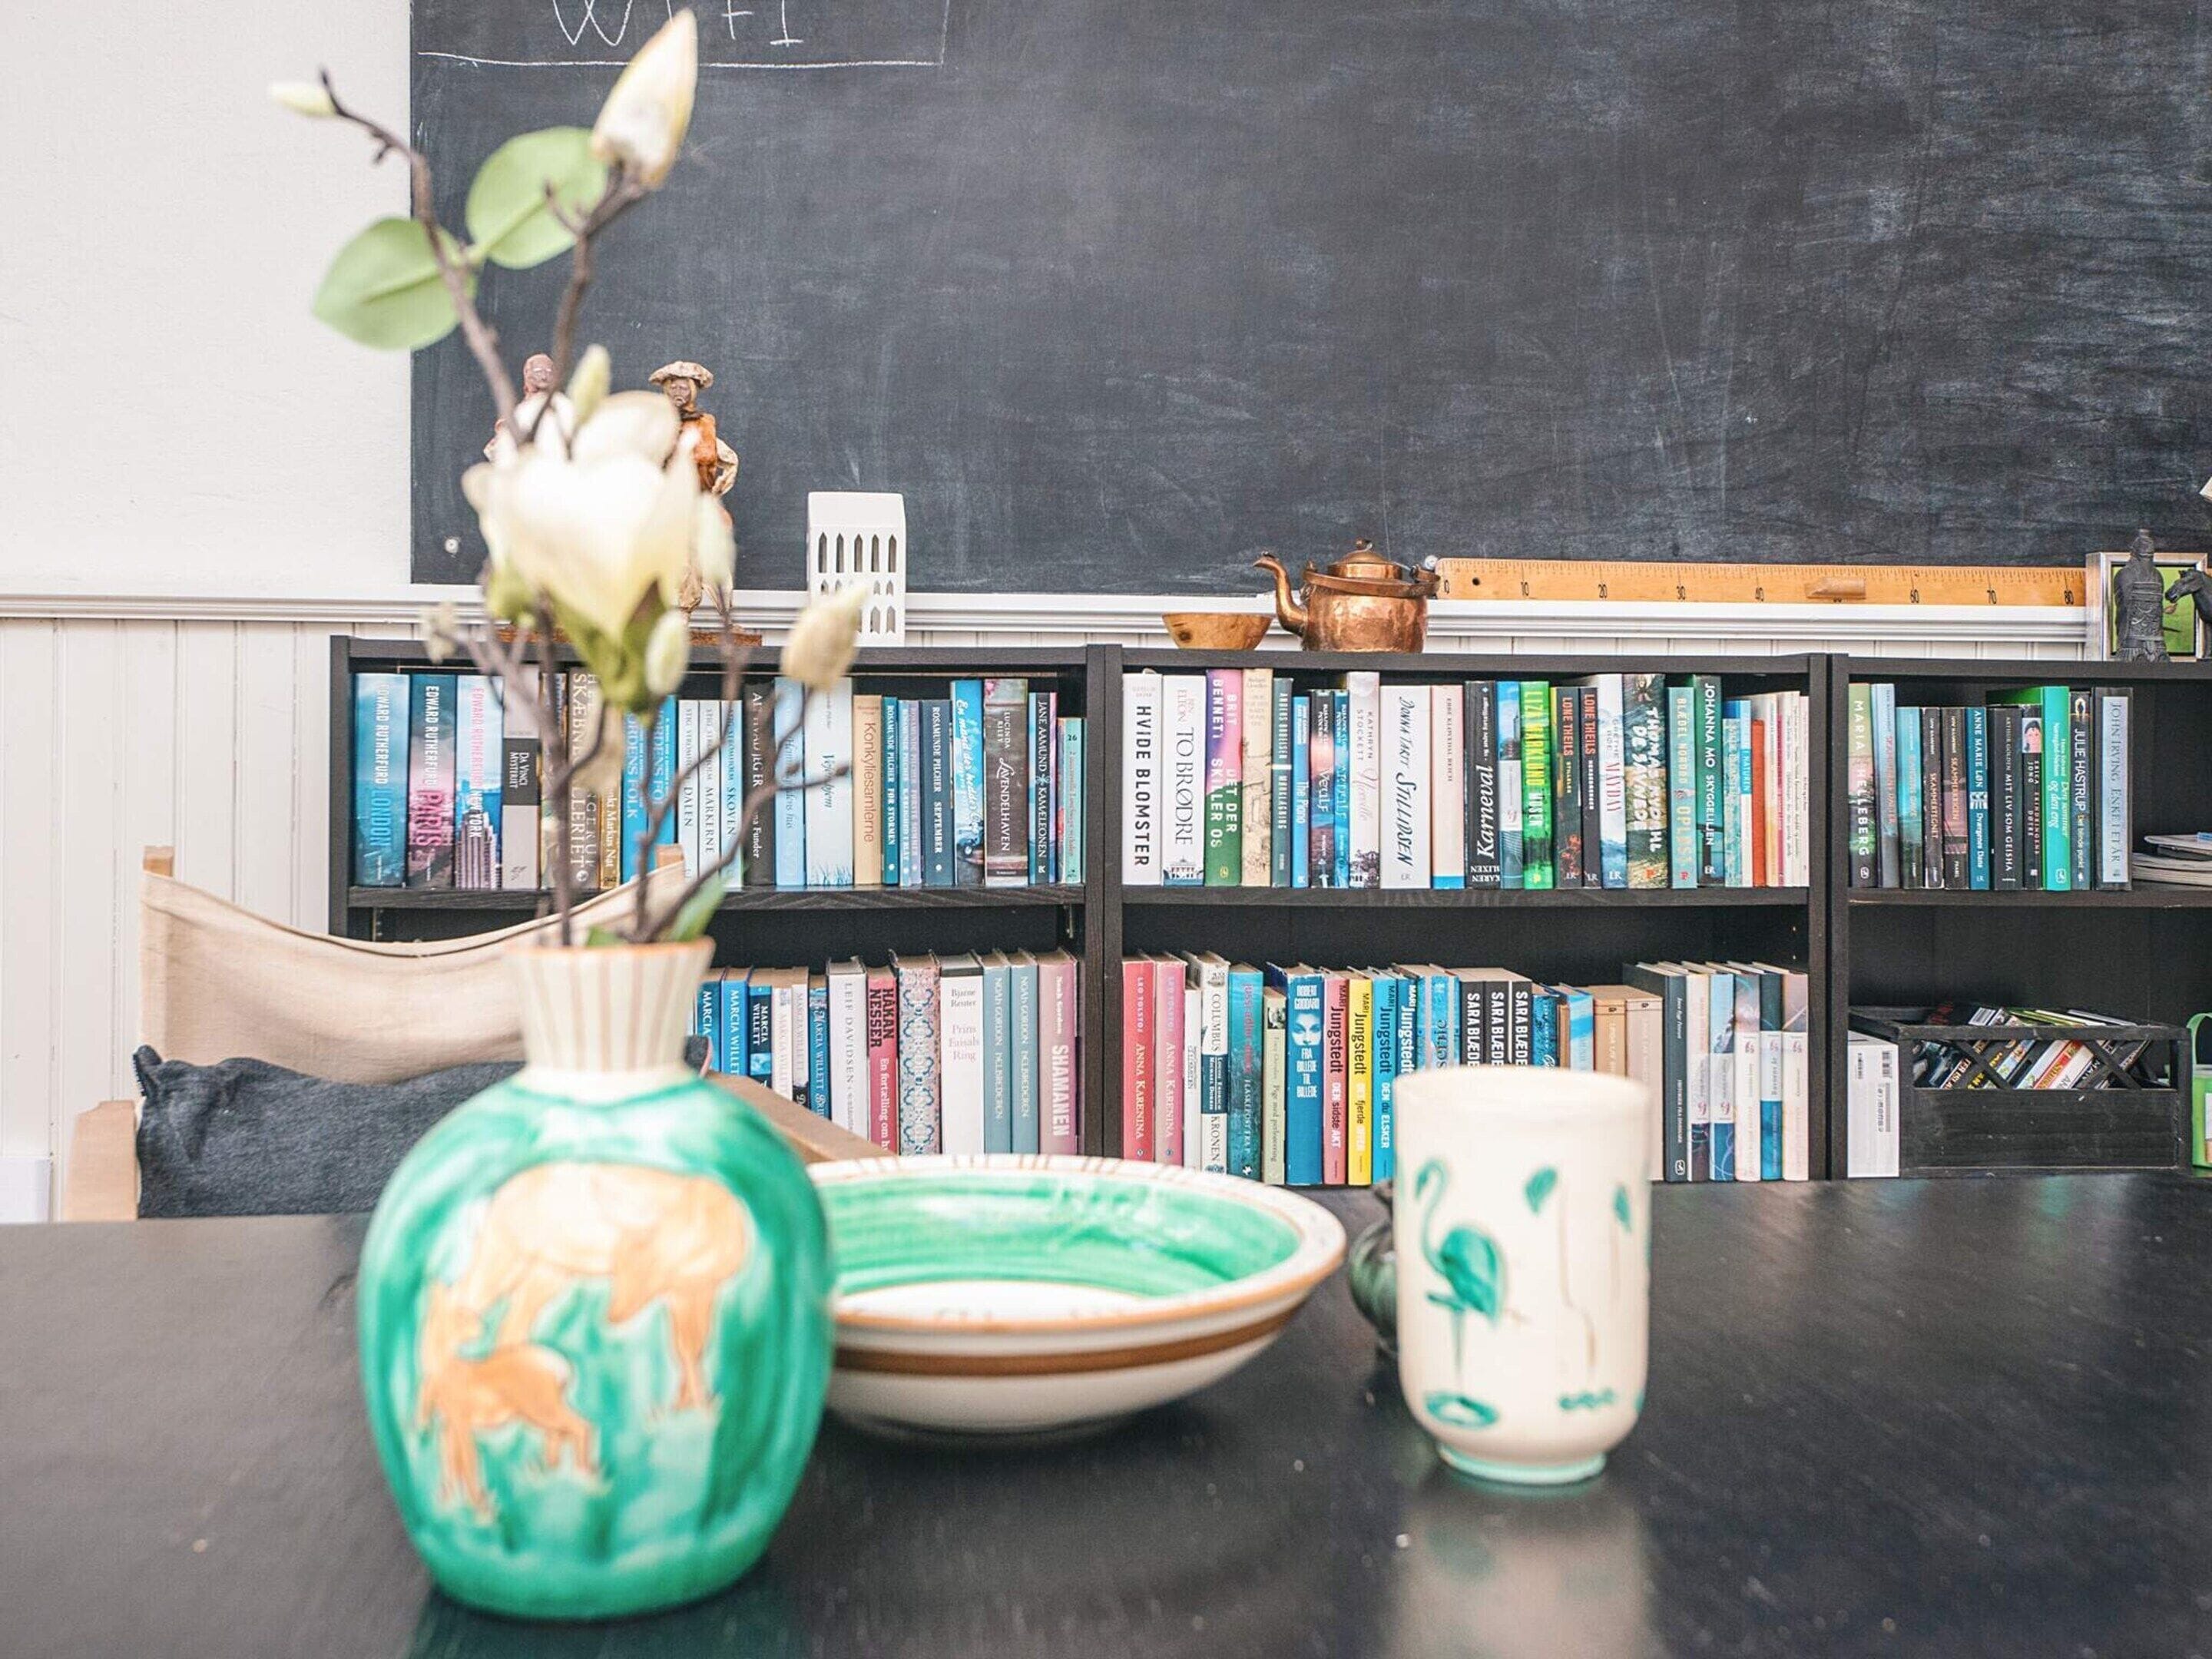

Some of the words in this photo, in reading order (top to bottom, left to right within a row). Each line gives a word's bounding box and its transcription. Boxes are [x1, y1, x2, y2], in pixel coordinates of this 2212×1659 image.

[1520, 581, 1529, 596] 10
[1598, 583, 1608, 598] 20
[1676, 584, 1686, 600] 30
[1755, 587, 1764, 602] 40
[1909, 589, 1919, 604] 60
[1987, 590, 1997, 604] 70
[2065, 591, 2074, 605] 80
[376, 684, 390, 721] EDWARD
[424, 685, 439, 723] EDWARD
[469, 688, 485, 725] EDWARD
[1038, 700, 1048, 725] JANE
[1212, 678, 1224, 740] BENNETT
[1227, 694, 1237, 726] BRIT
[1399, 697, 1416, 735] DONNA
[1524, 692, 1543, 722] LIZA
[1562, 697, 1573, 722] LONE
[1584, 694, 1595, 719] LONE
[1677, 697, 1688, 739] BLÆDEL
[1704, 683, 1716, 743] JOHANNA
[932, 707, 942, 757] ROSAMUNDE
[1136, 706, 1152, 760] HVIDE
[1584, 721, 1596, 755] THEILS
[1632, 726, 1645, 748] DE
[1853, 700, 1865, 750] MARIA
[1974, 710, 1983, 736] ANNE
[2111, 704, 2122, 738] JOHN
[376, 724, 390, 784] RUTHERFURD
[424, 726, 440, 786] RUTHERFURD
[1038, 727, 1048, 773] AAMUND
[1175, 727, 1195, 757] TO
[1525, 725, 1546, 787] MARKLUND
[1563, 724, 1574, 757] THEILS
[1705, 747, 1716, 768] MO
[1974, 737, 1983, 767] MARIE
[2074, 727, 2086, 757] JULIE
[933, 758, 942, 793] PILCHER
[1975, 770, 1984, 788] LØN
[2111, 740, 2122, 783] IRVING
[752, 773, 763, 788] ER
[860, 721, 877, 843] Konkyliesamlerne
[1210, 757, 1224, 820] SKILLER
[1226, 768, 1237, 798] DET
[1296, 780, 1310, 796] The
[1605, 762, 1621, 813] MAYDAY
[2005, 773, 2013, 792] MIT
[2048, 780, 2059, 791] og
[2074, 760, 2086, 812] HASTRUP
[369, 788, 392, 846] LONDON
[469, 790, 484, 810] NEW
[626, 780, 637, 819] FOLK
[684, 786, 694, 827] DALEN
[727, 786, 736, 836] SKOVEN
[997, 757, 1015, 852] LAVENDELHAVEN
[1134, 768, 1151, 866] BLOMSTER
[1175, 761, 1194, 845] BRØDRE
[1296, 800, 1309, 824] Piano
[1475, 765, 1495, 859] Karneval
[1705, 774, 1715, 846] SKYGGELILJEN
[1857, 767, 1869, 856] HELLEBERG
[2005, 796, 2013, 810] LIV
[2111, 788, 2122, 821] ENKE
[415, 790, 443, 846] PARIS
[469, 813, 484, 838] YORK
[705, 786, 715, 853] MARKERNE
[934, 801, 942, 854] SEPTEMBER
[1038, 786, 1048, 858] KAMÆLEONEN
[1226, 803, 1238, 833] DER
[1396, 773, 1417, 868] STILLIDSEN
[2005, 813, 2013, 834] SOM
[752, 826, 762, 859] Funder
[1210, 829, 1223, 849] OS
[2005, 836, 2014, 872] GEISHA
[844, 983, 853, 1013] LEIF
[1136, 977, 1144, 994] LEO
[1388, 985, 1396, 1007] MARI
[1408, 985, 1416, 1007] MARI
[703, 991, 713, 1035] MARCIA
[730, 989, 740, 1032] MARCIA
[869, 988, 882, 1048] NESSER
[882, 988, 895, 1039] HÅKAN
[1362, 993, 1370, 1014] MARI
[1467, 992, 1480, 1025] SARA
[1492, 992, 1505, 1025] SARA
[1515, 991, 1528, 1024] SARA
[752, 1002, 761, 1046] WILLETT
[760, 1005, 770, 1043] MARCIA
[814, 1010, 826, 1048] MARCIA
[1210, 993, 1222, 1052] COLUMBUS
[1377, 1006, 1393, 1074] Jungstedt
[1399, 1005, 1415, 1074] Jungstedt
[845, 1017, 856, 1084] DAVIDSEN
[952, 1050, 976, 1061] Ring
[1300, 1048, 1313, 1059] FRA
[1328, 1007, 1343, 1074] Jungstedt
[1352, 1012, 1368, 1075] Jungstedt
[1492, 1027, 1505, 1066] BLÆDE
[1515, 1026, 1528, 1065] BLÆDE
[815, 1051, 823, 1090] WILLETT
[880, 1058, 889, 1071] En
[1135, 1043, 1147, 1075] ANNA
[1165, 1042, 1177, 1075] ANNA
[879, 1072, 890, 1121] fortælling
[1051, 1045, 1070, 1136] SHAMANEN
[1165, 1079, 1177, 1137] KARENINA
[1332, 1082, 1341, 1101] DEN
[1381, 1082, 1390, 1101] DEN
[1381, 1102, 1389, 1114] du
[1135, 1080, 1146, 1139] KARENINA
[1332, 1101, 1341, 1128] sidste
[1356, 1100, 1366, 1124] fjerde
[881, 1122, 889, 1137] om
[1210, 1116, 1221, 1161] KRONEN
[1332, 1130, 1341, 1148] AKT
[1381, 1114, 1391, 1149] ELSKER
